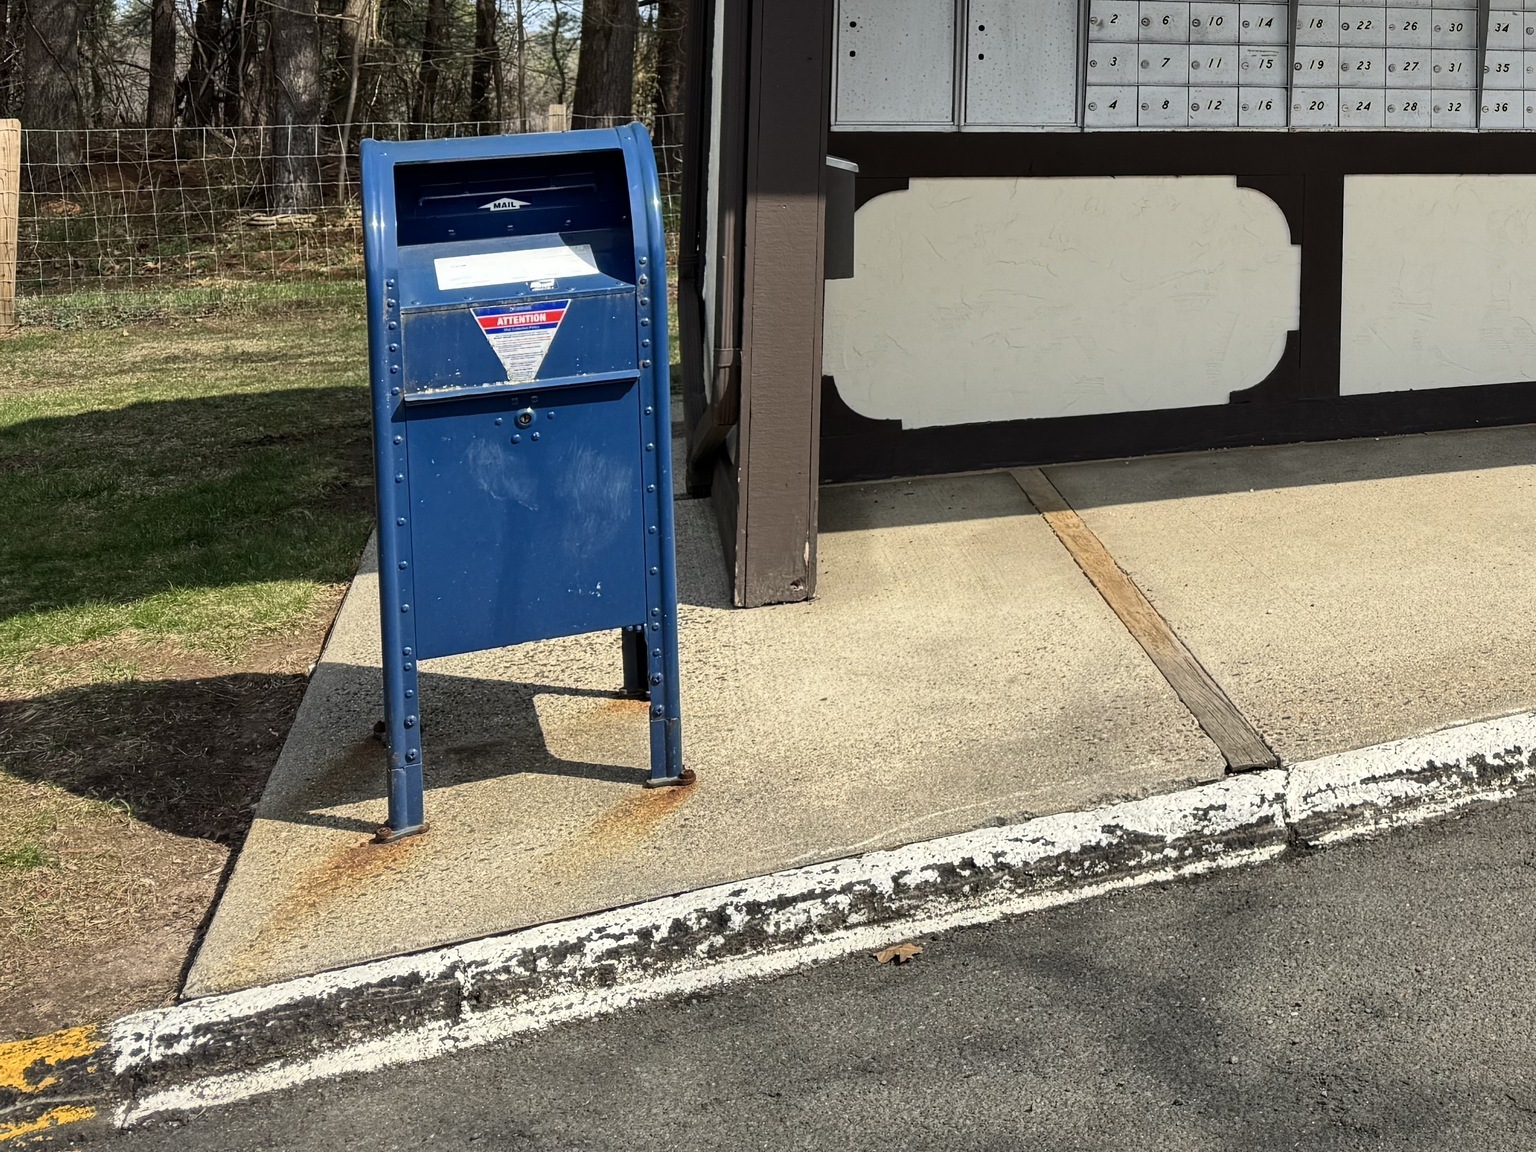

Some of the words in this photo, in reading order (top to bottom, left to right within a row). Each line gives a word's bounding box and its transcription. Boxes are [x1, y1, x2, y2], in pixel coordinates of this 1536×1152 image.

[1109, 13, 1119, 25] 2
[1161, 14, 1171, 26] 6
[1208, 15, 1224, 27] 10
[1258, 17, 1274, 29] 14
[1308, 18, 1324, 29] 18
[1356, 19, 1373, 31] 22
[1402, 20, 1419, 32] 26
[1448, 22, 1464, 33] 30
[1494, 22, 1510, 34] 34
[1109, 56, 1118, 67] 3
[1160, 56, 1171, 68] 7
[1208, 57, 1223, 69] 11
[1258, 58, 1274, 70] 15
[1309, 59, 1325, 70] 19
[1356, 60, 1372, 71] 23
[1402, 61, 1419, 72] 27
[1448, 62, 1463, 73] 31
[1495, 62, 1511, 74] 35
[1108, 99, 1118, 110] 4
[1161, 99, 1170, 111] 8
[1207, 99, 1223, 111] 12
[1257, 100, 1273, 111] 16
[1308, 100, 1325, 111] 20
[1355, 100, 1372, 112] 24
[1402, 101, 1419, 112] 28
[1447, 101, 1462, 113] 32
[1493, 102, 1509, 113] 36
[493, 201, 517, 209] MAIL
[497, 313, 547, 326] ATTENTION
